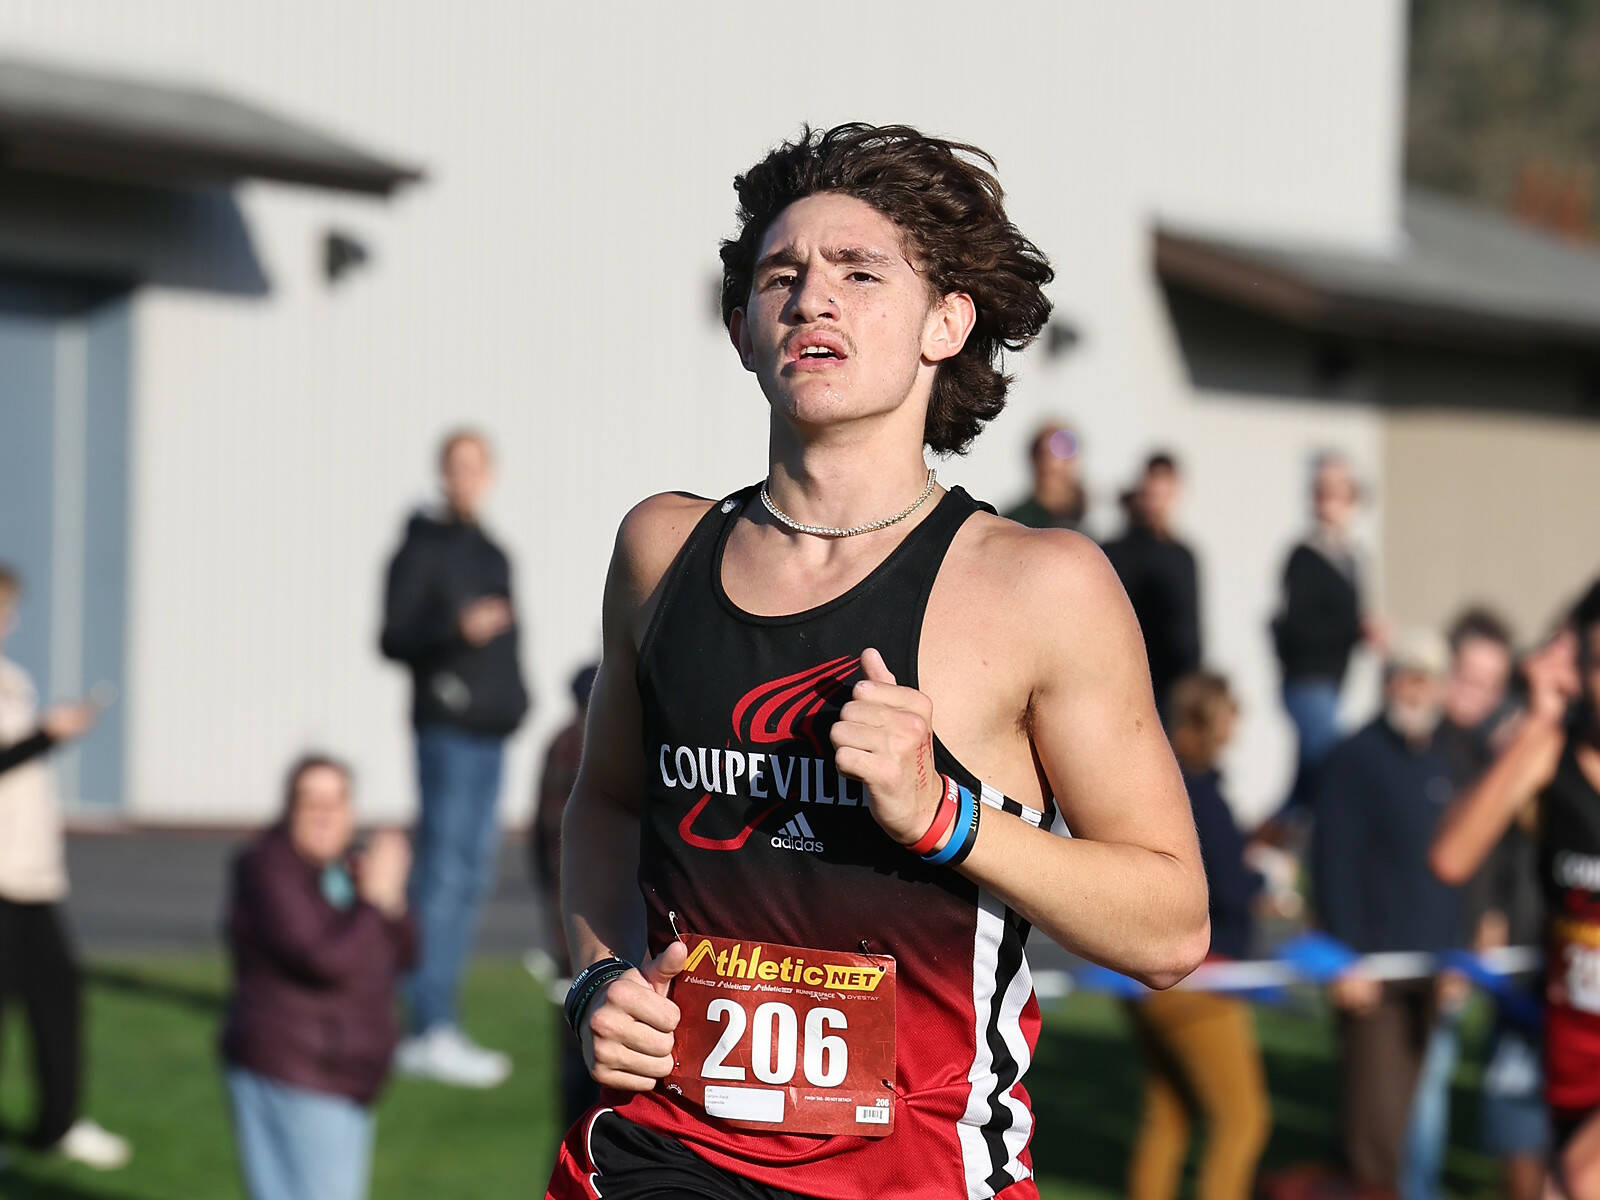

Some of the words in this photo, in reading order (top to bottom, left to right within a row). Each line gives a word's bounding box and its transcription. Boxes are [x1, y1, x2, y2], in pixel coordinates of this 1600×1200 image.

[659, 744, 868, 807] COUPEVILL
[770, 836, 824, 853] adidas
[701, 998, 848, 1088] 206
[875, 1097, 890, 1107] 206
